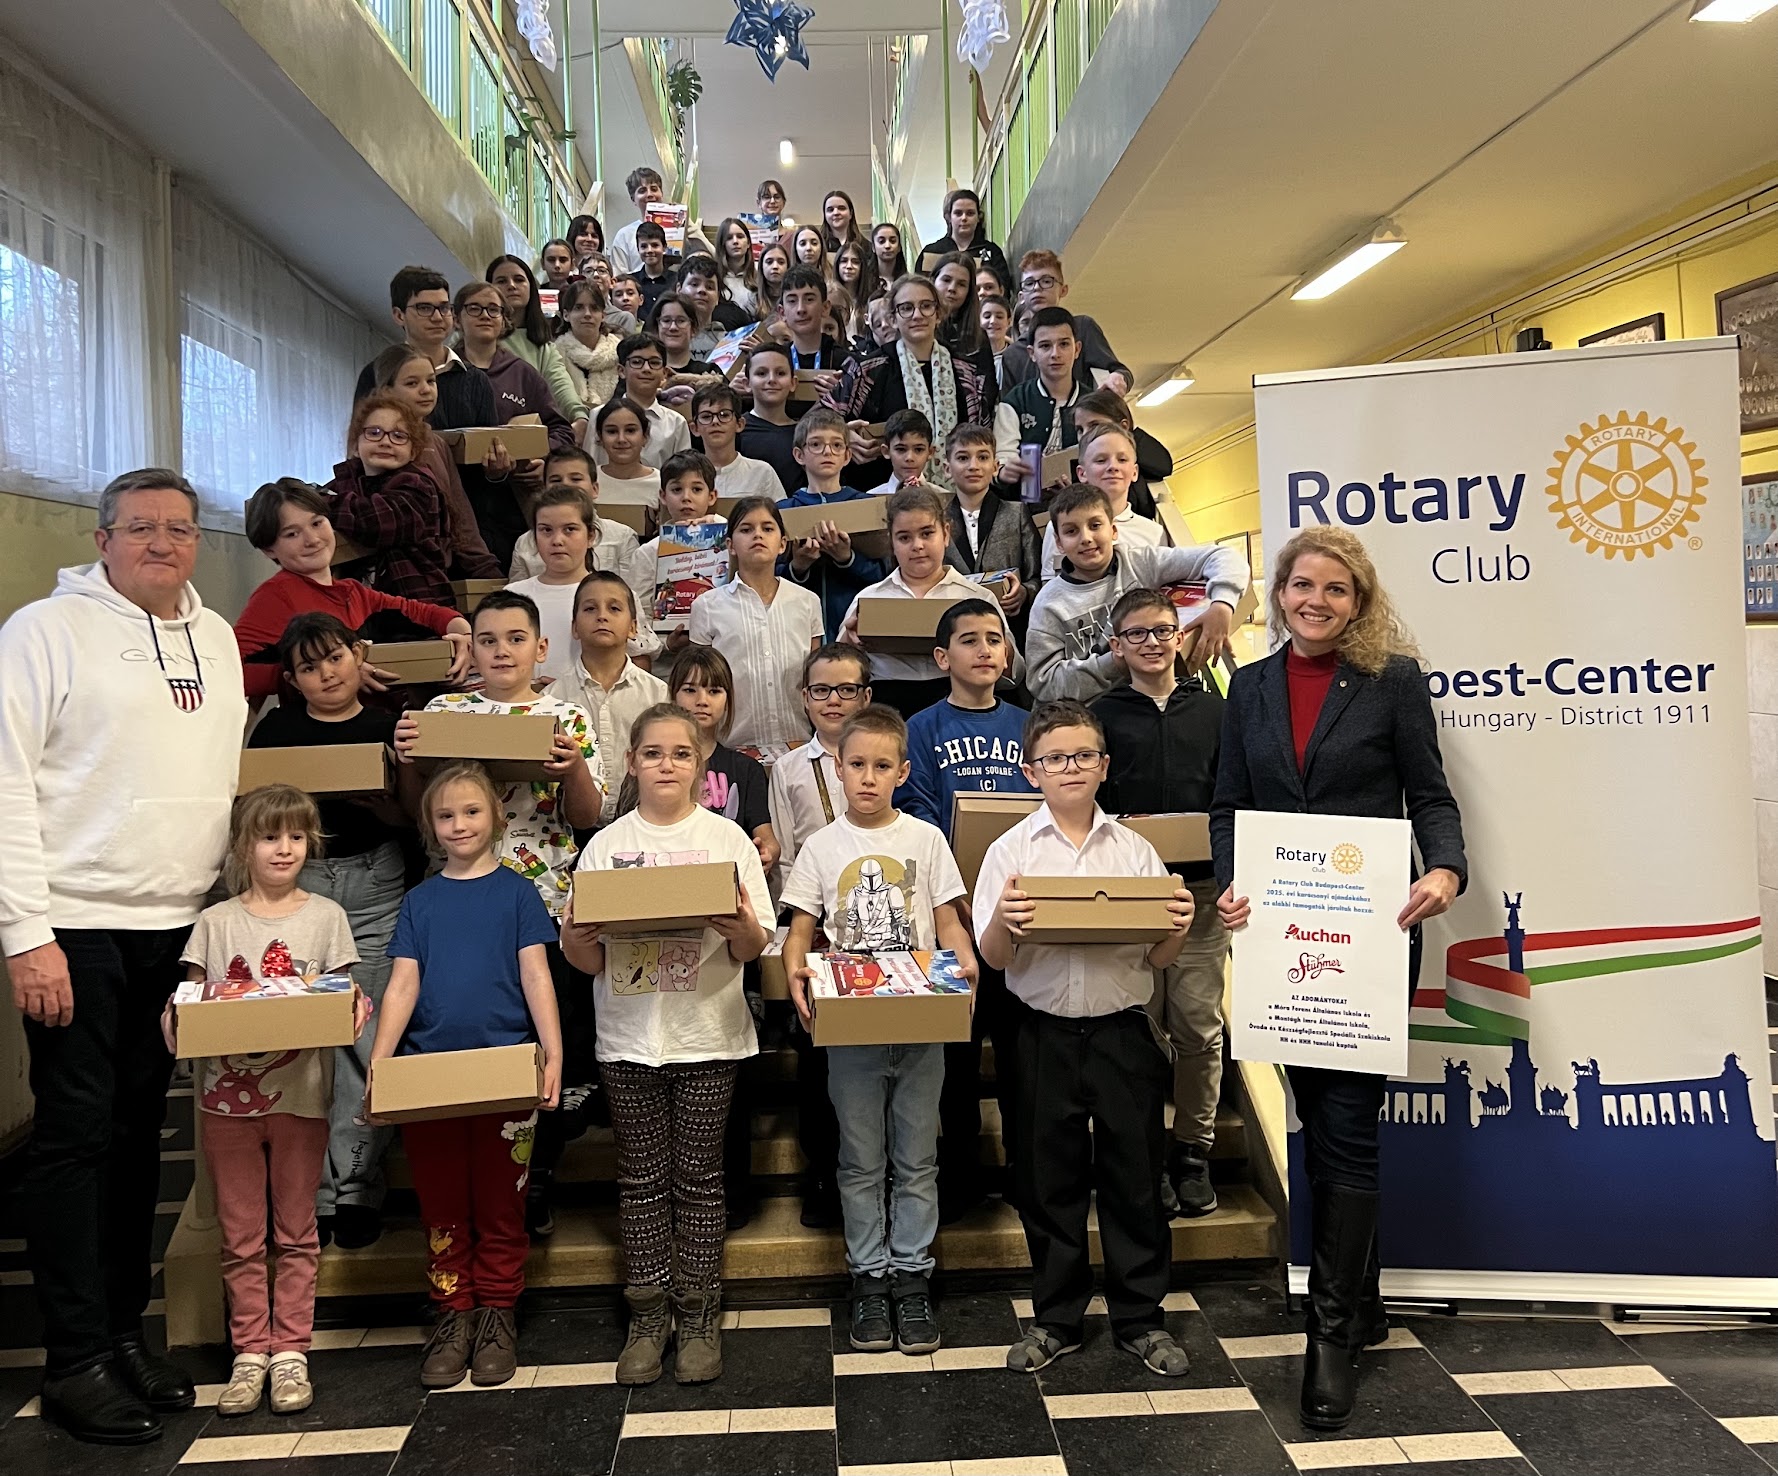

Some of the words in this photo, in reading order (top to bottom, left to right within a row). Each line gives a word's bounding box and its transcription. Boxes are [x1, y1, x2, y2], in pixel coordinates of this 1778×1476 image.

[1590, 427, 1658, 447] ROTARY
[1288, 469, 1526, 532] Rotary
[1572, 506, 1685, 545] INTERNATIONAL
[1432, 545, 1531, 584] Club
[1441, 708, 1537, 732] Hungary
[1561, 706, 1643, 727] District
[1653, 704, 1711, 725] 1911
[1275, 846, 1326, 865] Rotary
[1278, 879, 1298, 887] Rotary
[1284, 923, 1351, 945] Auchan
[1301, 995, 1348, 1005] ADOMÁNYOKAT
[351, 1140, 369, 1176] togethe
